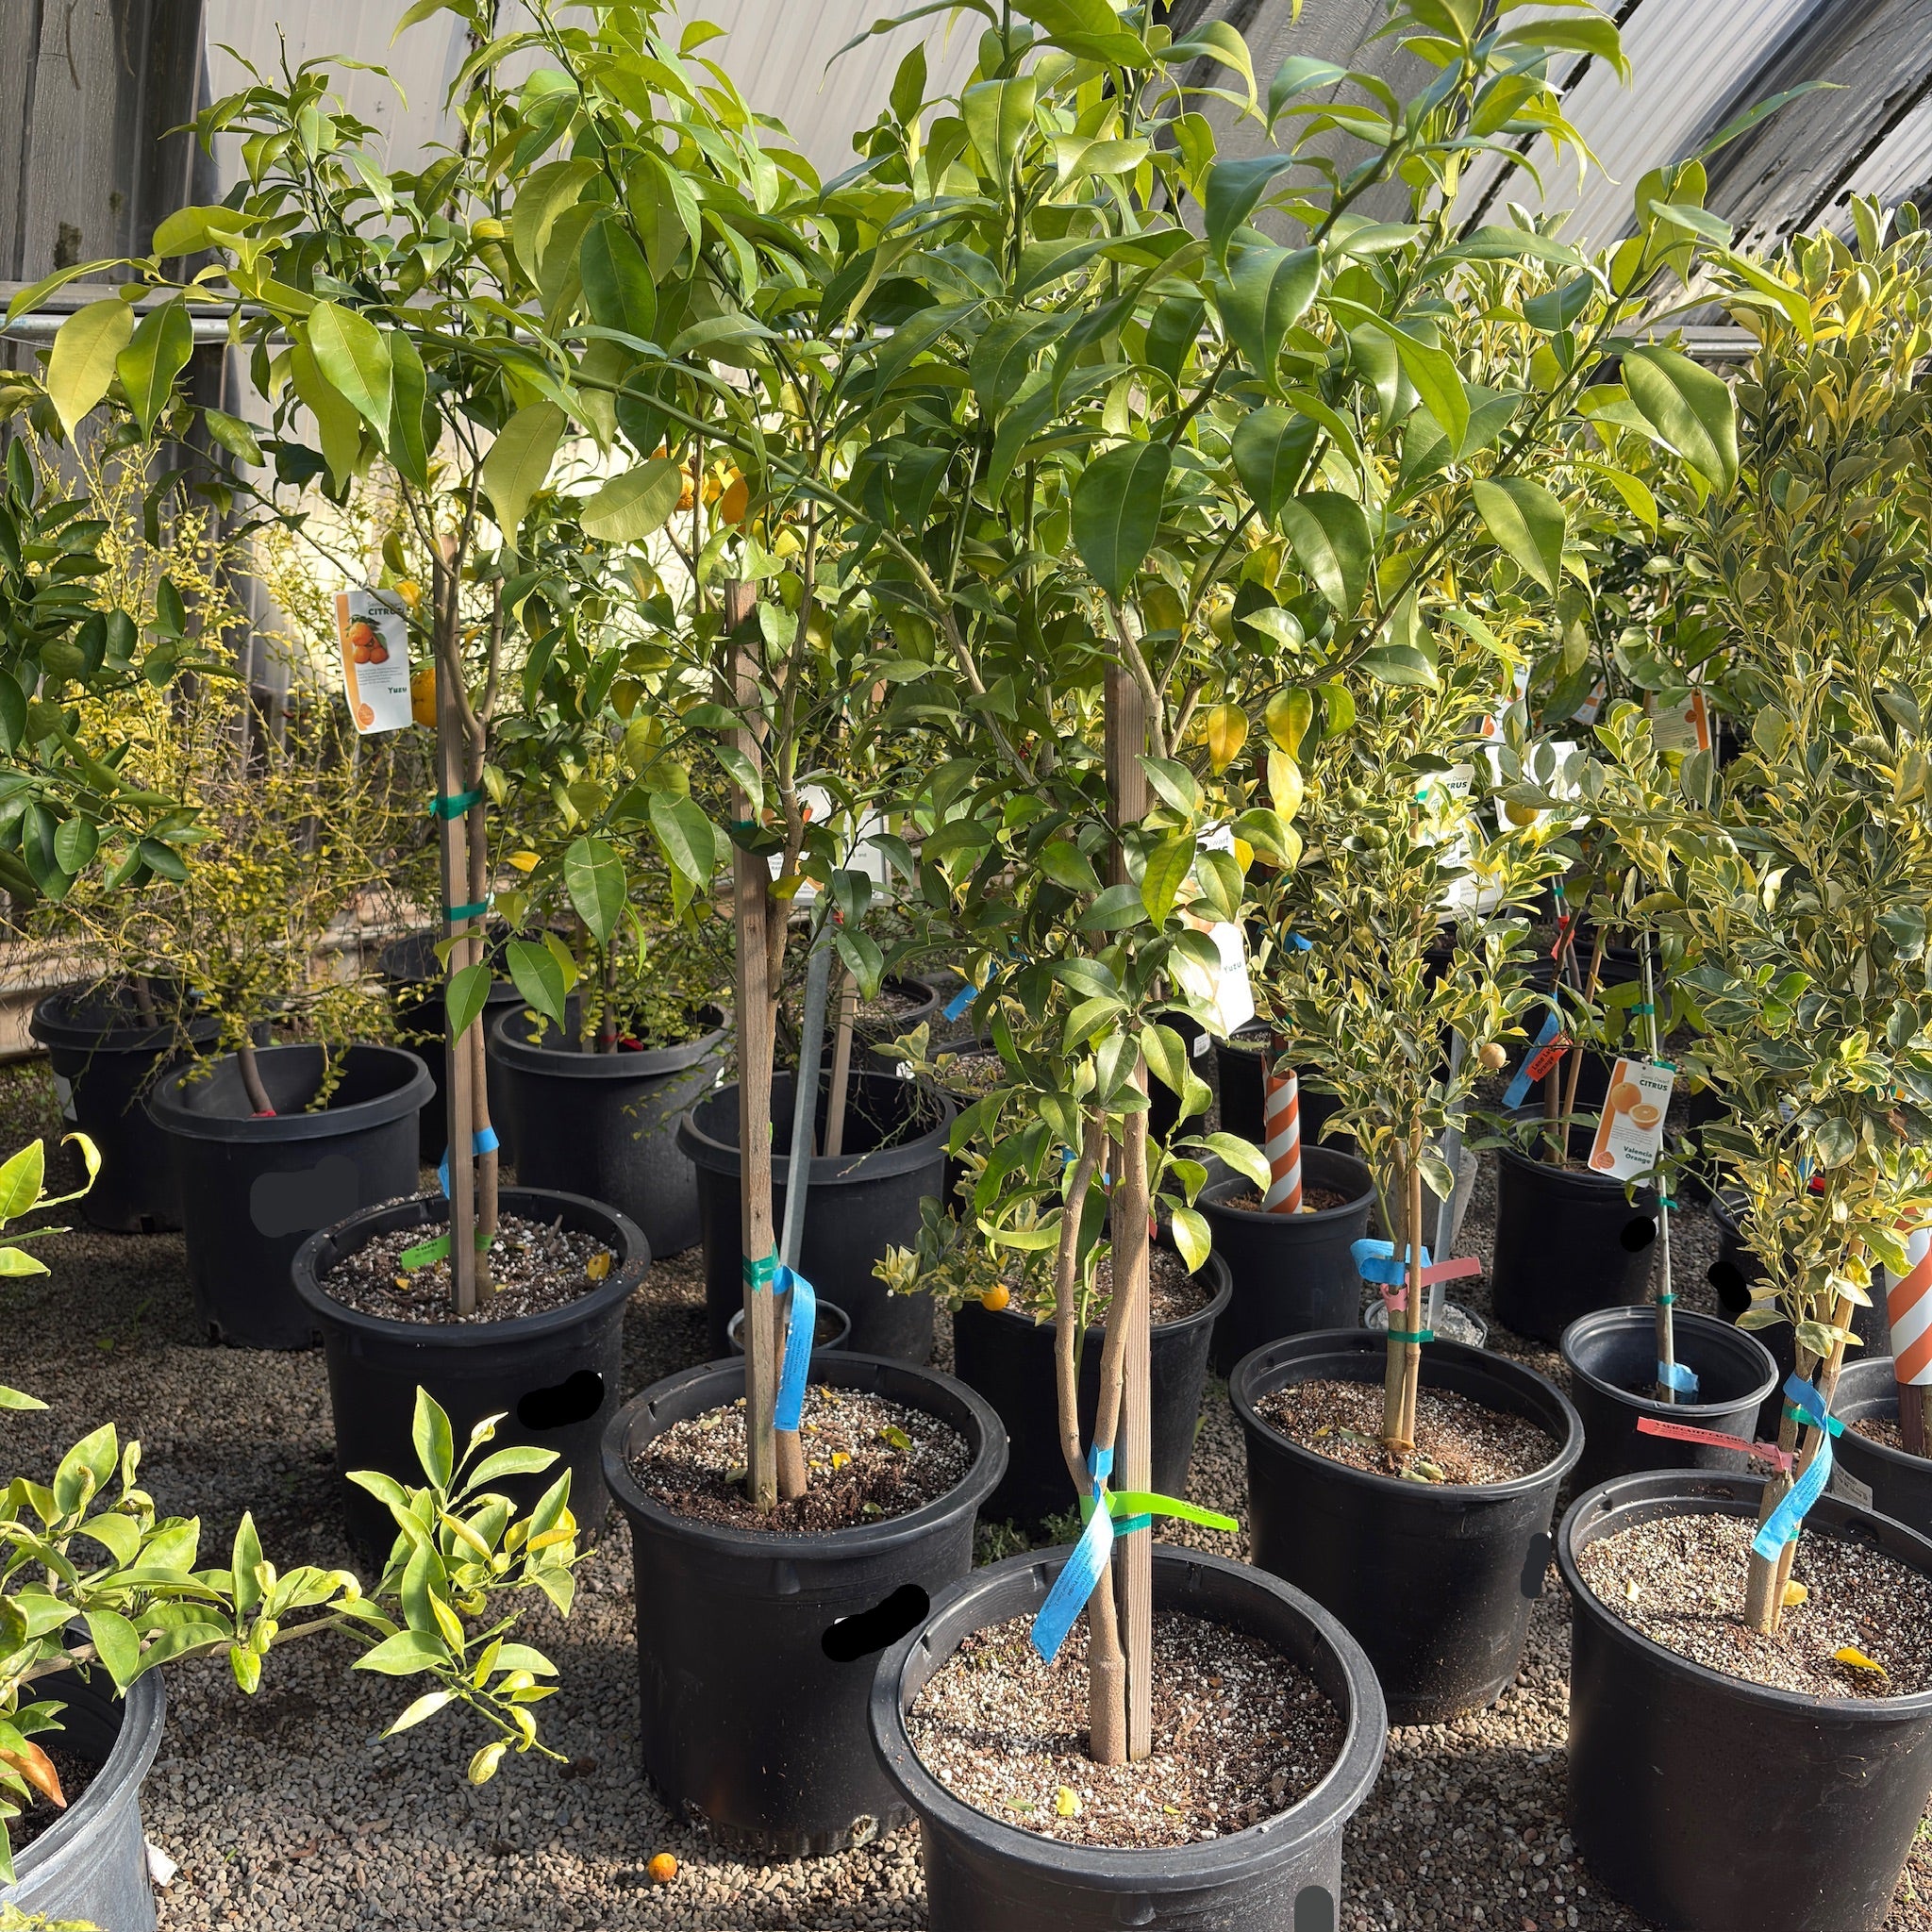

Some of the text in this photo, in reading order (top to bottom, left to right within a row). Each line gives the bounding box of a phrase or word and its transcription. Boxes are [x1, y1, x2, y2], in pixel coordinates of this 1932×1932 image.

[368, 607, 404, 616] CITRU
[388, 686, 408, 694] Yuzu
[1446, 781, 1468, 790] TRUS
[1224, 961, 1241, 974] Yuzu
[1531, 1047, 1553, 1070] Lane Lat
[1537, 1056, 1554, 1074] Orange
[1640, 1079, 1668, 1091] CITRUS
[1624, 1145, 1653, 1158] Valencia
[1624, 1153, 1651, 1164] Orange
